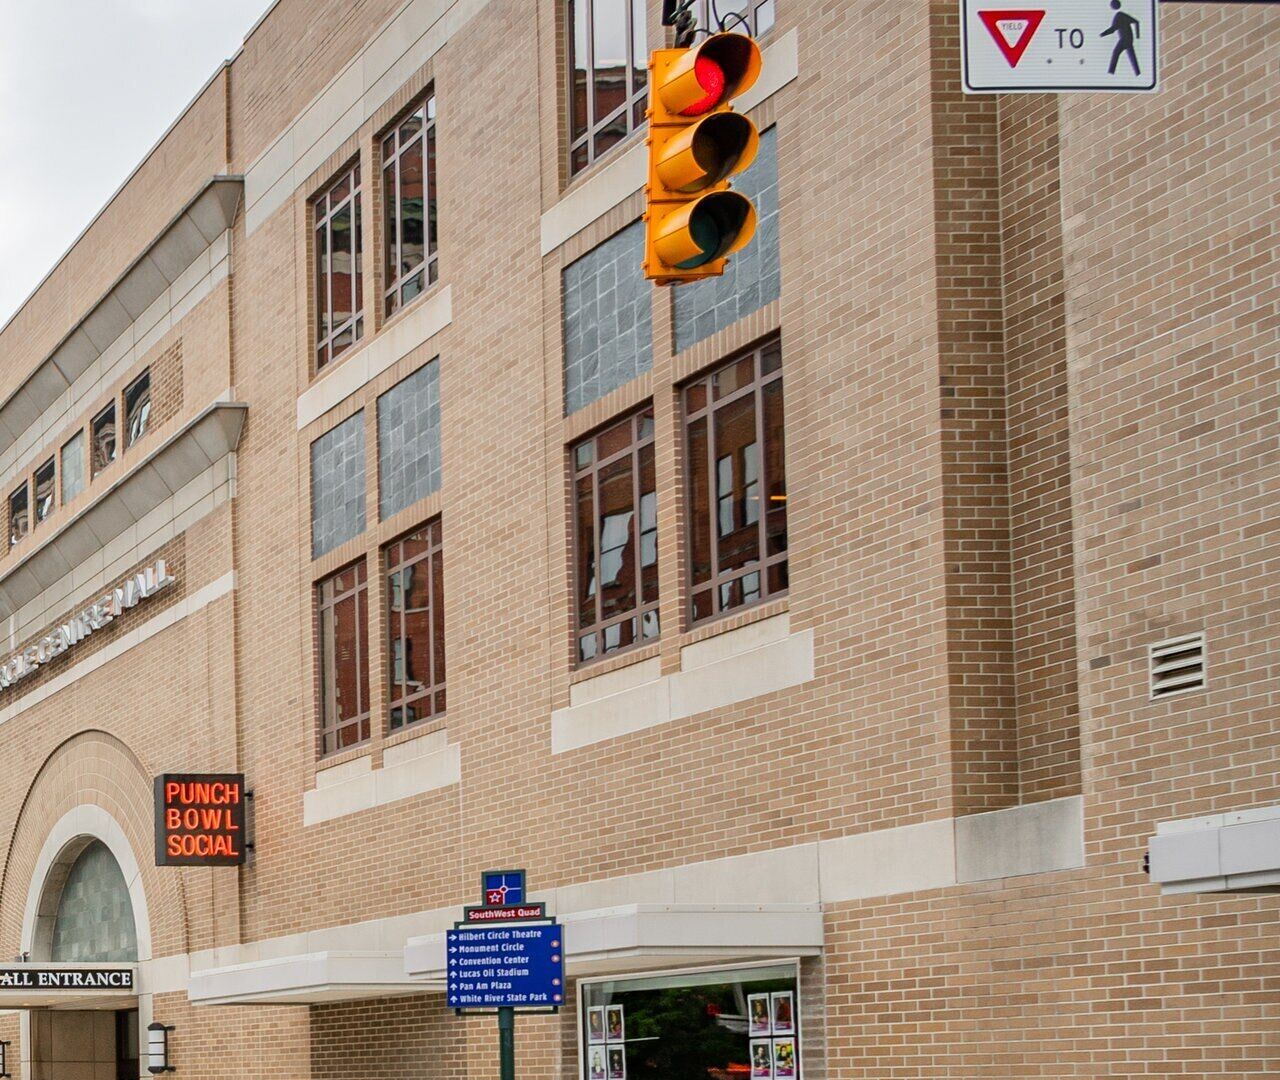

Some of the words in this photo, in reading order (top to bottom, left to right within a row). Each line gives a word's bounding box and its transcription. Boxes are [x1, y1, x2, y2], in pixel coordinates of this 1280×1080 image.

[1001, 23, 1023, 31] YIELD
[1054, 28, 1085, 49] TO
[113, 560, 175, 616] MALL
[166, 782, 239, 804] PUNCH
[167, 808, 239, 830] BOWL
[167, 834, 239, 856] SOCIAL
[469, 908, 515, 919] SouthWest
[518, 907, 540, 917] Quad
[459, 931, 485, 941] Hilbert
[487, 930, 510, 940] Circle
[512, 929, 542, 938] Theatre
[459, 943, 499, 953] Monument
[501, 942, 524, 951] Circle
[459, 957, 501, 966] Convention
[503, 955, 529, 964] Center
[459, 969, 480, 978] Lucas
[483, 968, 494, 977] Oil
[497, 967, 529, 976] Stadium
[38, 972, 131, 986] ENTRANCE
[460, 982, 474, 990] Pan
[476, 982, 488, 990] Am
[491, 981, 512, 989] Plaza
[460, 994, 482, 1003] White
[484, 993, 504, 1002] River
[506, 993, 527, 1001] State
[529, 992, 547, 1001] Park
